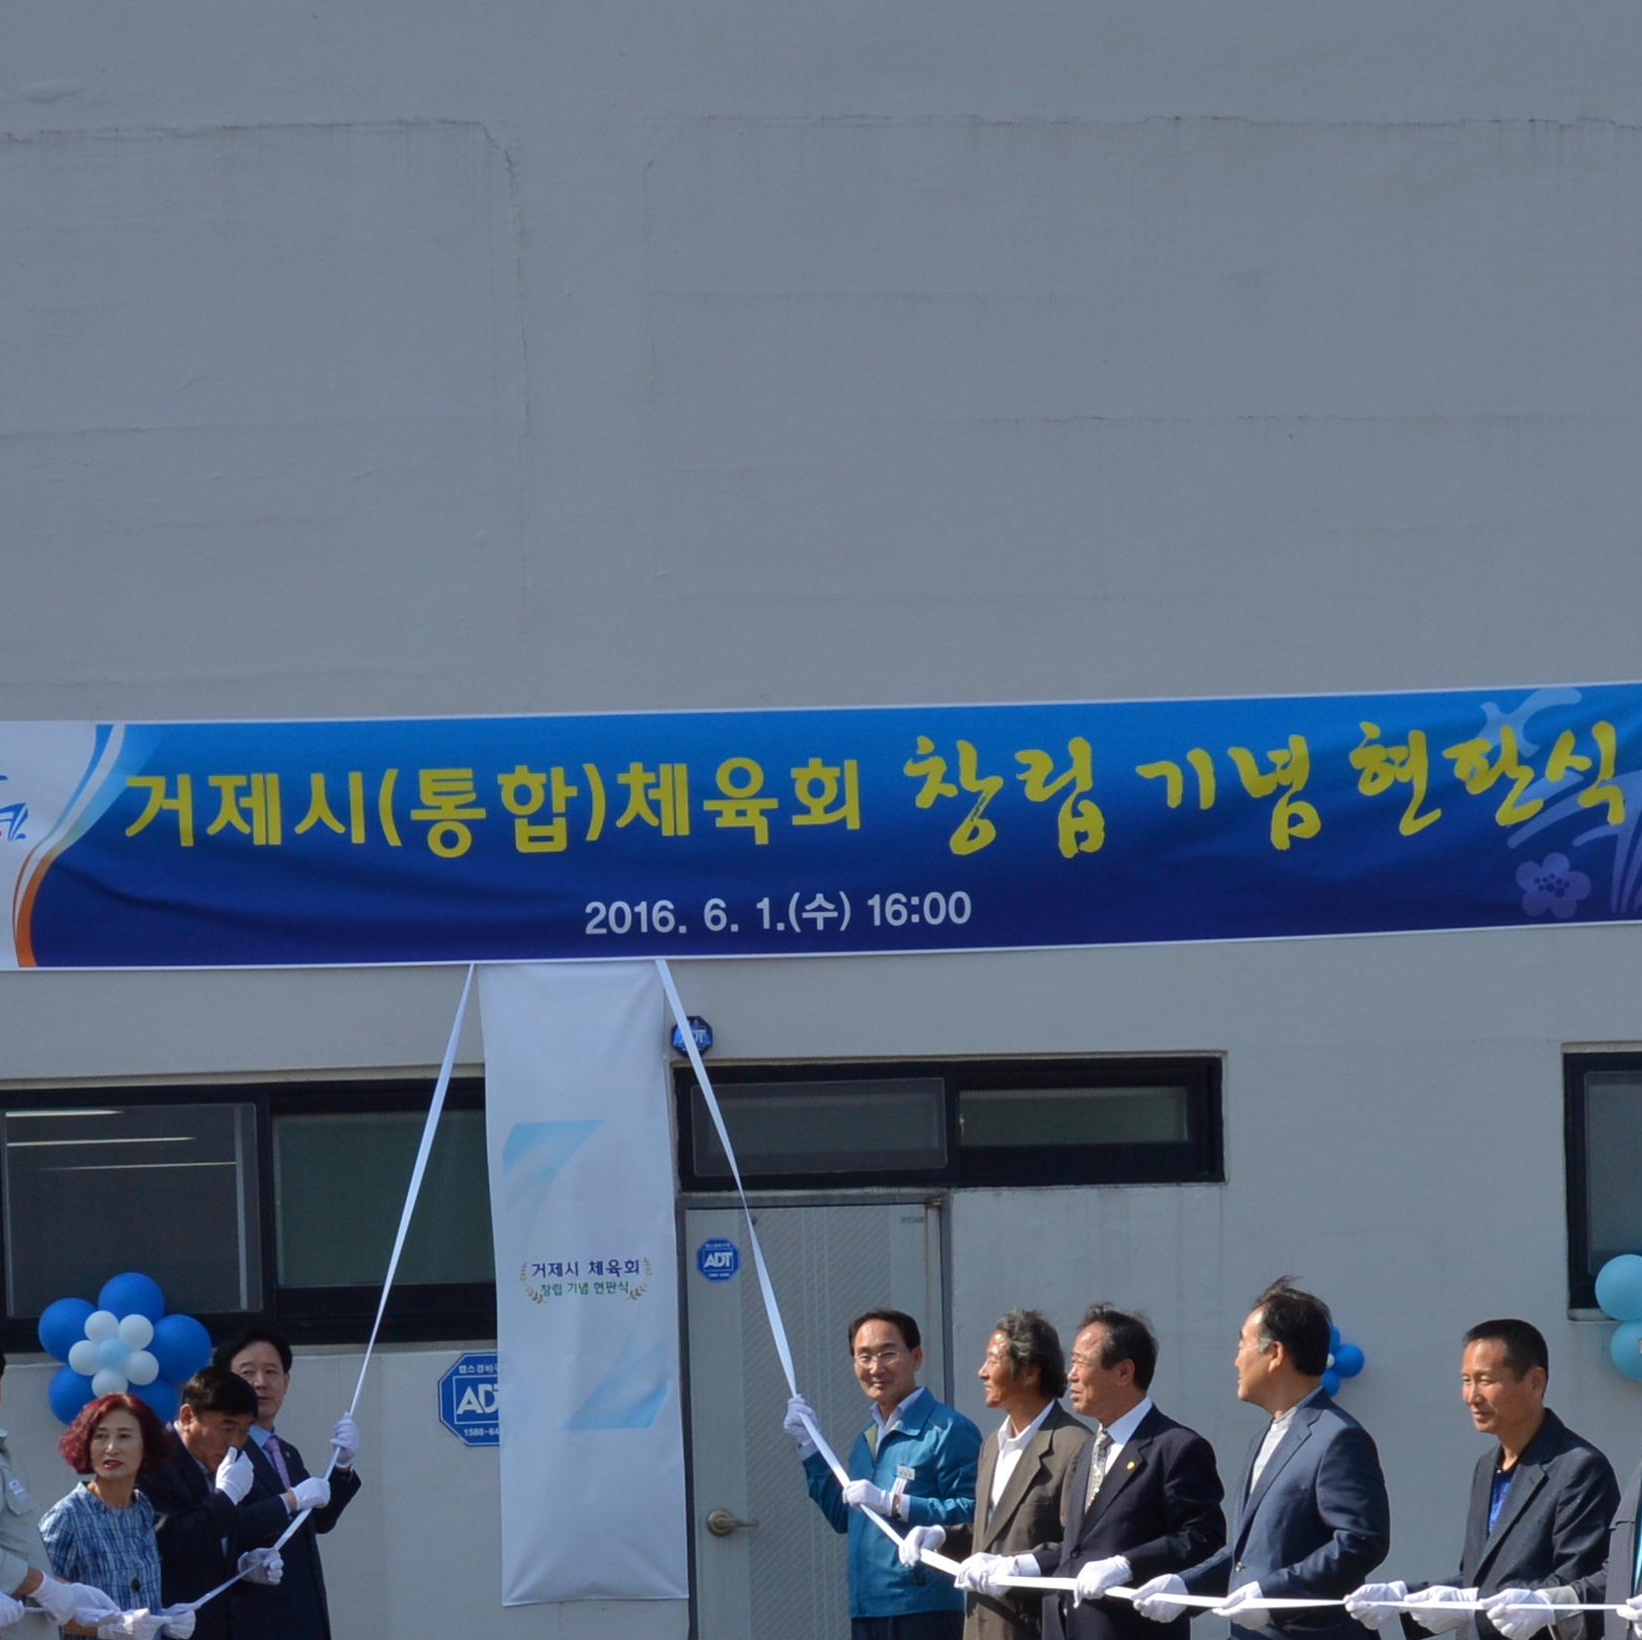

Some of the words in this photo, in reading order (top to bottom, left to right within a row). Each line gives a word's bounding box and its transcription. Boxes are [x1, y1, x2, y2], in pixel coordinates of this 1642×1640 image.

[124, 756, 860, 858] 거제시(통합)체육회
[903, 735, 1105, 858] 창립
[1135, 733, 1321, 851] 기념
[1348, 720, 1626, 837] 현판식
[585, 900, 687, 935] 2016.
[703, 898, 739, 933] 6.
[867, 890, 972, 927] 16:00
[531, 1261, 579, 1278] 거제시
[588, 1259, 640, 1278] 체육회
[703, 1251, 734, 1268] ADT
[540, 1283, 563, 1298] 창립
[567, 1282, 589, 1296] 기념
[593, 1280, 630, 1295] 현판식
